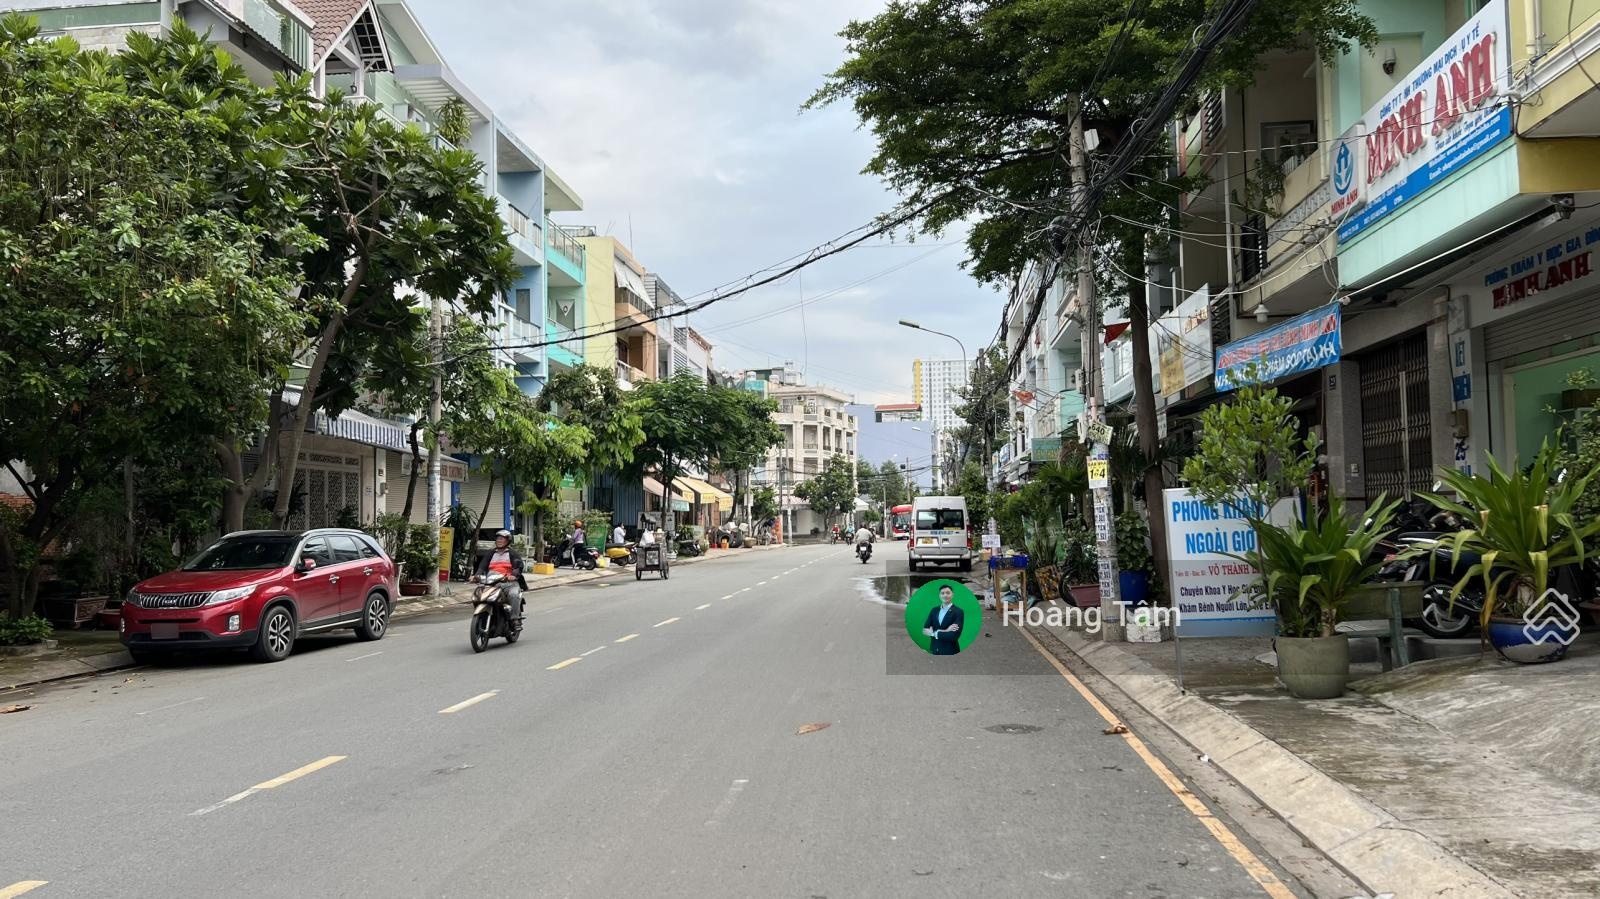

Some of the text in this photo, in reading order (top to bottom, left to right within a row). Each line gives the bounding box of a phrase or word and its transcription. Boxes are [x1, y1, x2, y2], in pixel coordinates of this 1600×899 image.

[1366, 90, 1427, 184] MINH
[1431, 32, 1497, 136] ANH
[1331, 197, 1345, 215] MINH
[1346, 187, 1358, 207] ANH
[1492, 251, 1593, 309] MINH ANH
[1185, 528, 1228, 554] NGOÀI
[1222, 562, 1249, 575] THÀNH
[1180, 585, 1203, 597] Chuyên
[1205, 585, 1220, 596] Khoa
[1222, 584, 1227, 595] Y
[1179, 603, 1198, 613] Khám
[1199, 602, 1215, 613] Bệnh
[1216, 602, 1235, 613] Người
